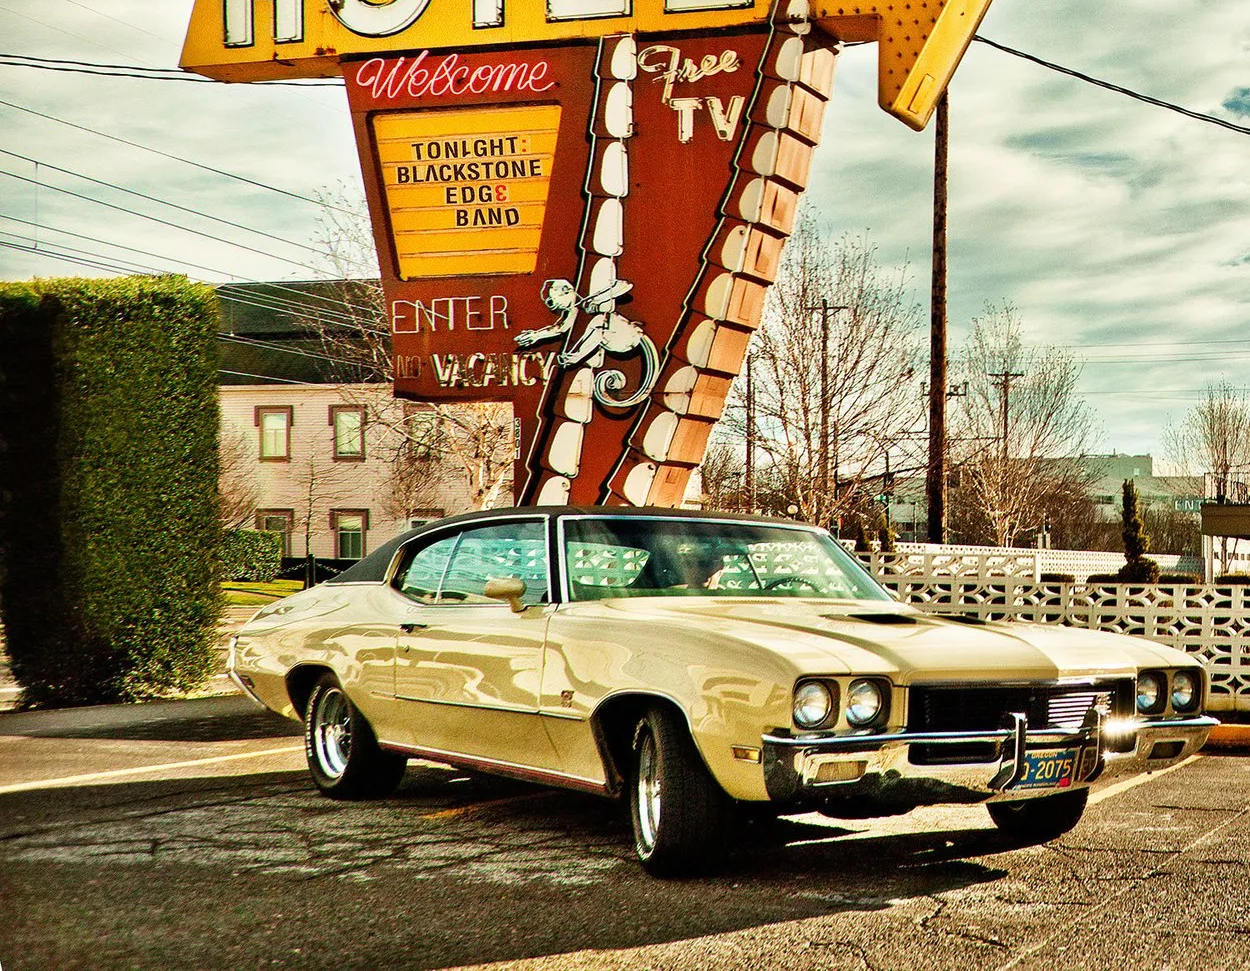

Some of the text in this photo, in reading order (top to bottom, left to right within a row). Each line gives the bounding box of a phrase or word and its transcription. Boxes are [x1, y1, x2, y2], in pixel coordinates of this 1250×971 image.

[355, 49, 555, 100] Welcome
[637, 44, 741, 105] Free
[667, 95, 746, 145] TV
[411, 136, 527, 160] TONIGHT:
[397, 159, 542, 184] BLACKSTONE
[455, 207, 521, 227] BAND
[392, 295, 509, 334] ENTER
[431, 352, 556, 388] VACANCY
